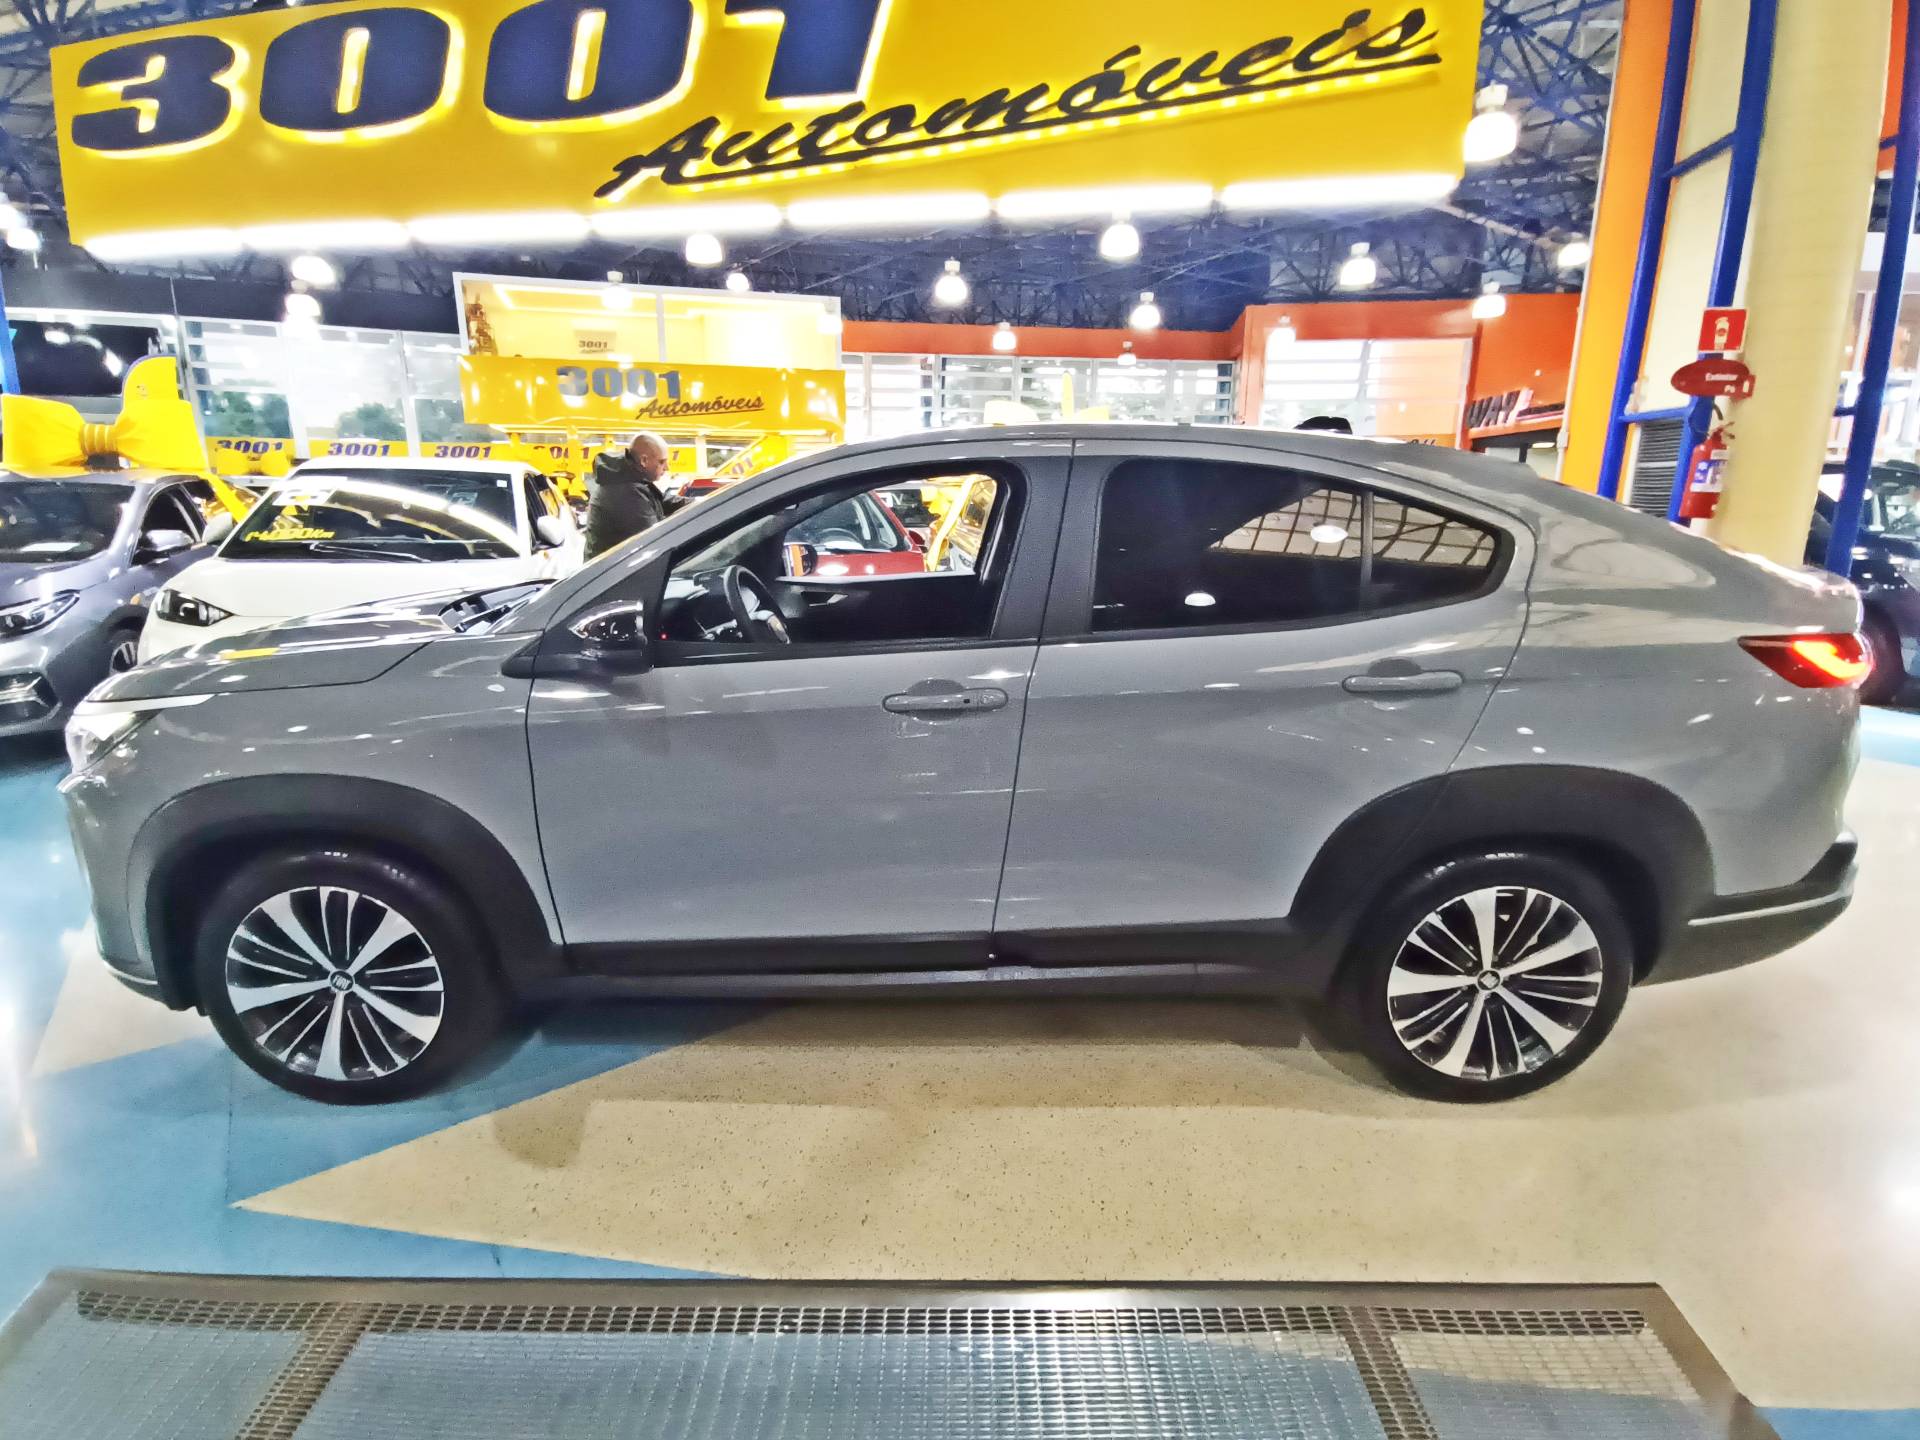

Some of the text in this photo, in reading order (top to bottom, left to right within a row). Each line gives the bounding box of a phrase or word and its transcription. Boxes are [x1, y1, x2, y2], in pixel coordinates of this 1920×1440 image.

[72, 0, 882, 152] 3001
[594, 7, 1440, 198] Automóveis
[556, 366, 681, 400] 3001
[635, 395, 766, 420] Automóveis
[328, 442, 390, 456] 3001
[434, 445, 492, 458] 3001
